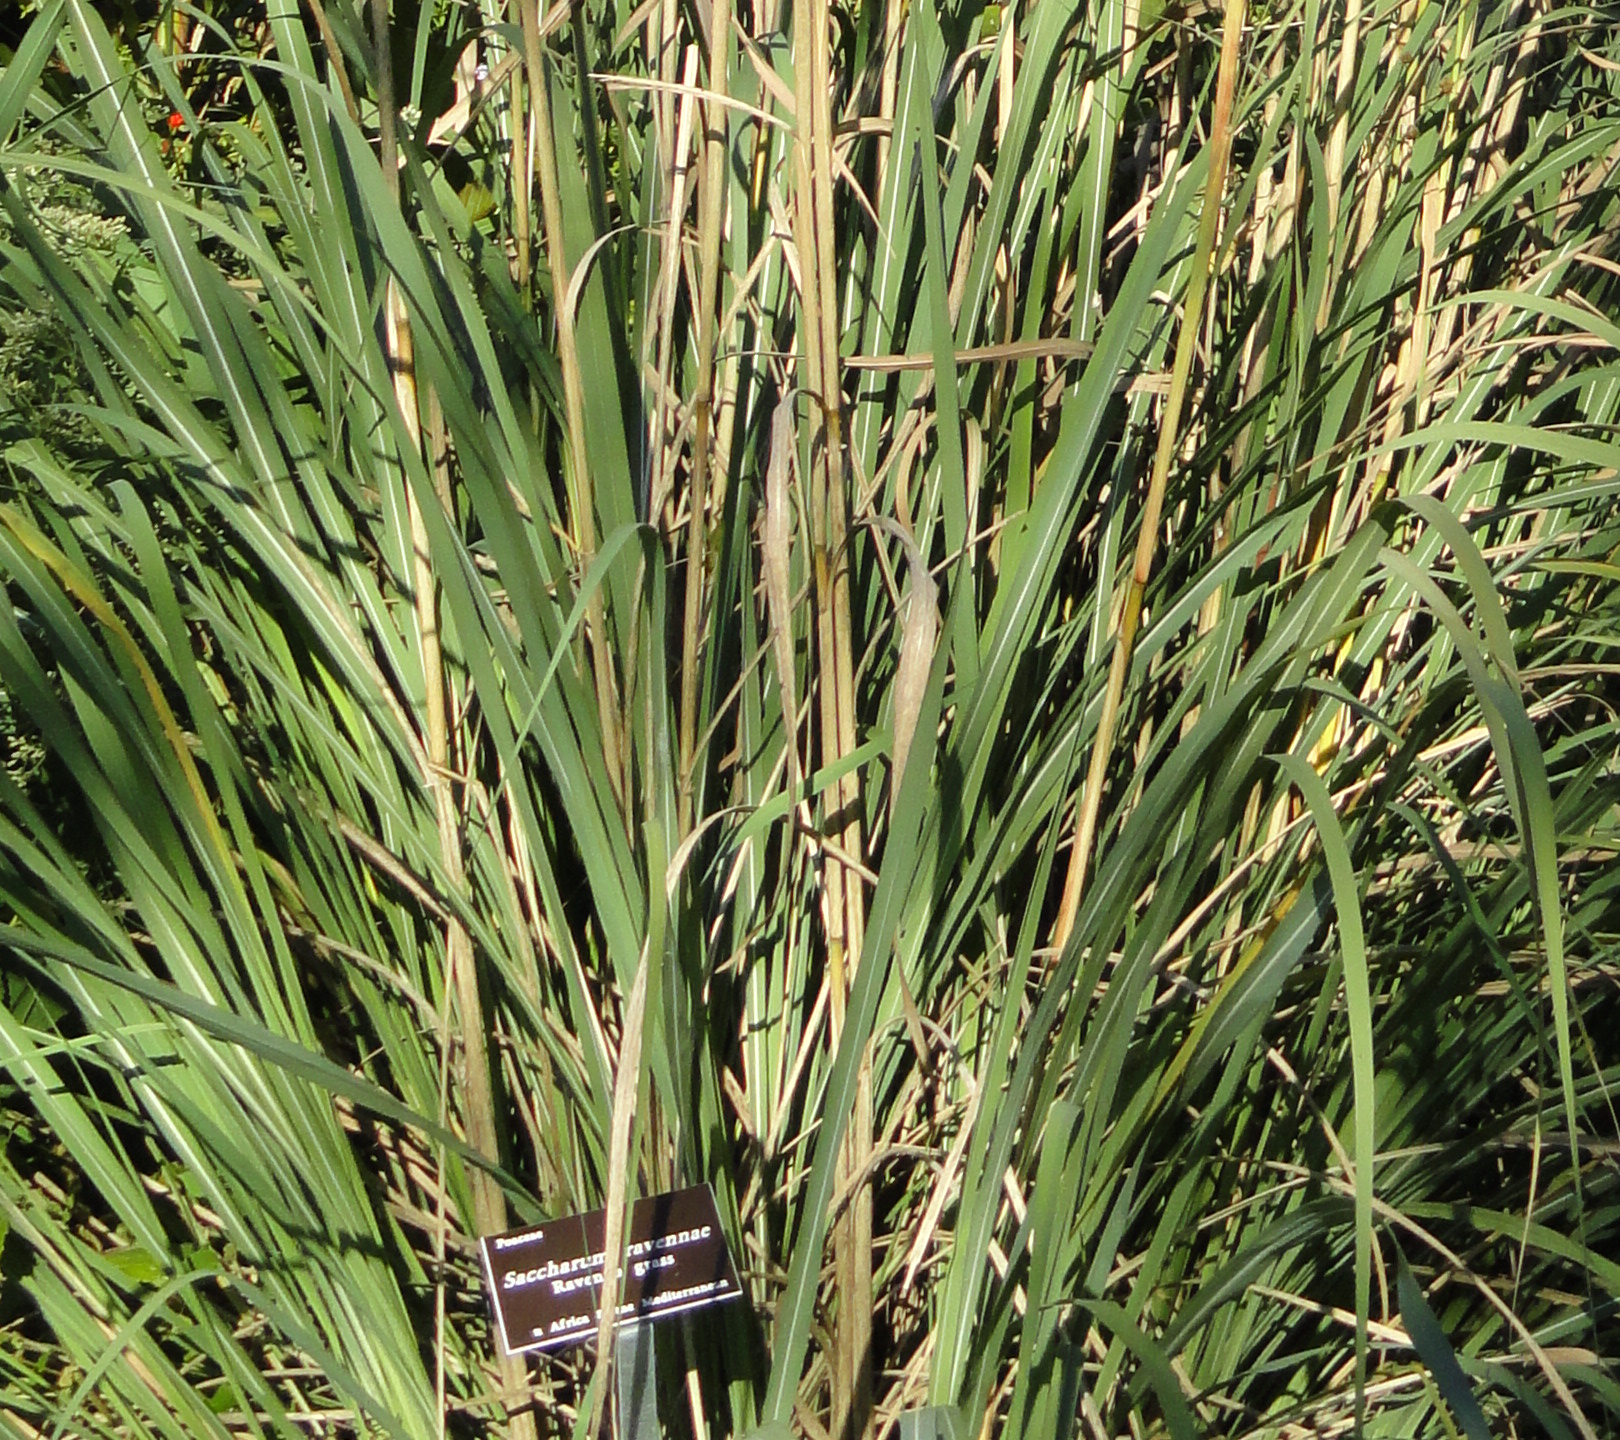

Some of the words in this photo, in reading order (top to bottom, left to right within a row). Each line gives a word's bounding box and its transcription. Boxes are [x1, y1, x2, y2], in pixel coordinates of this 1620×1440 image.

[625, 1225, 712, 1258] ravennae
[633, 1253, 676, 1277] grass
[550, 1314, 591, 1333] Africa
